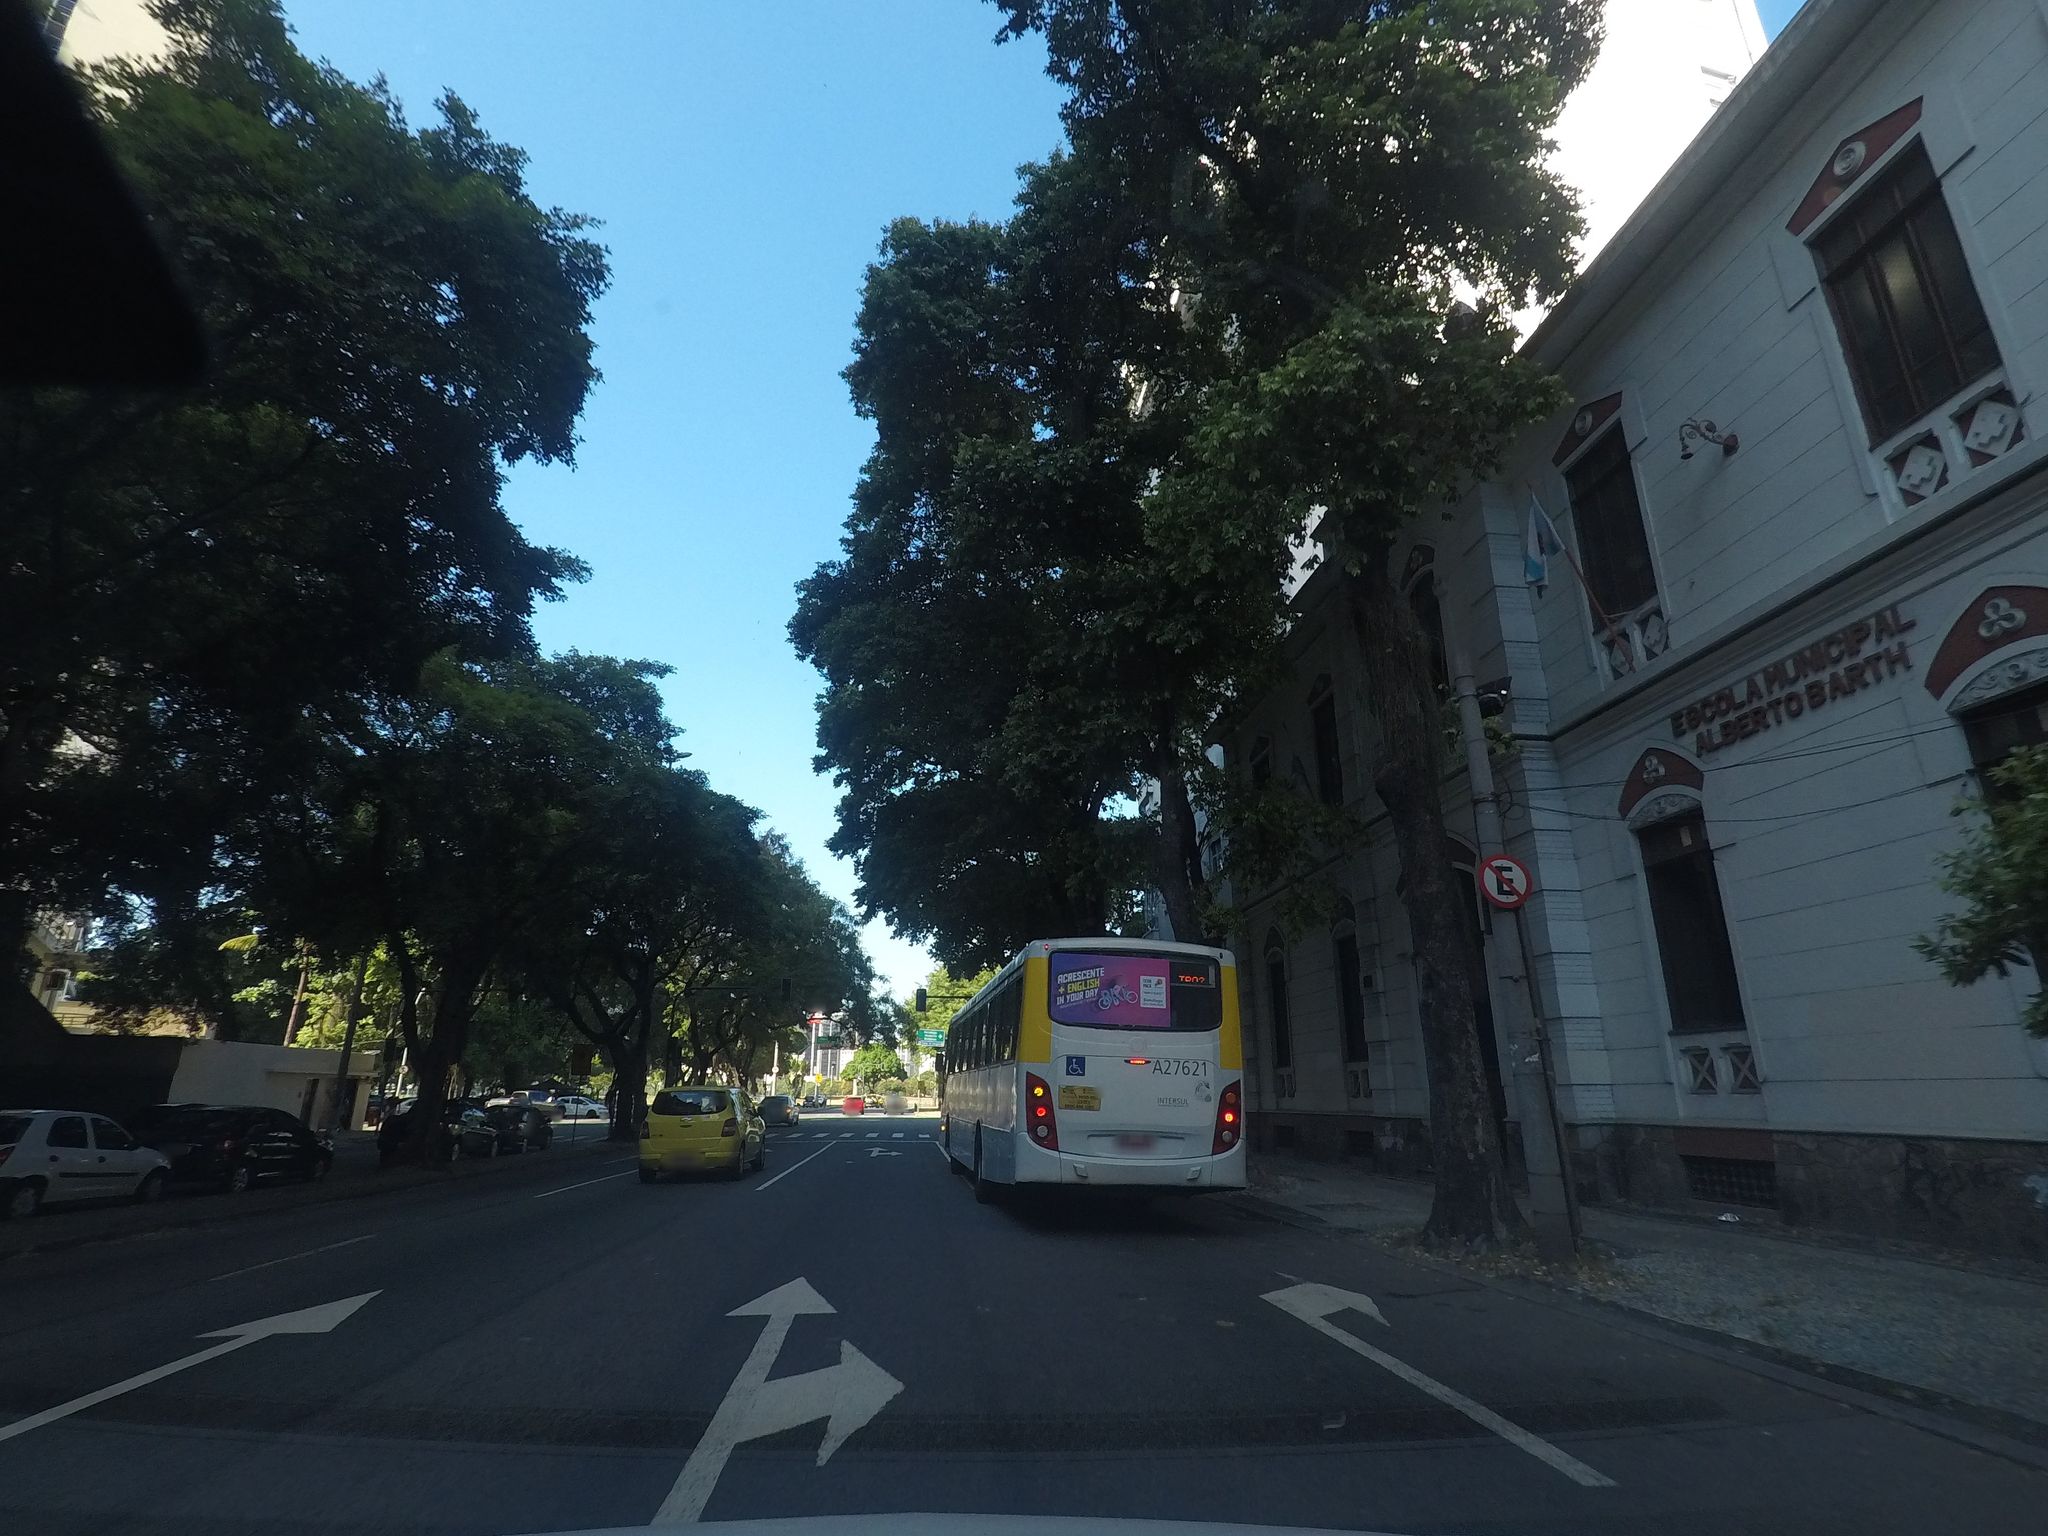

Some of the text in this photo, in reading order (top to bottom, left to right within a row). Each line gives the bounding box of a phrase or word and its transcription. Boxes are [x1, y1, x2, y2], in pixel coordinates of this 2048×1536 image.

[1670, 606, 1917, 738] ESCOLA MUNICIPAL
[1695, 640, 1913, 758] ALBERTO BARTH
[1494, 865, 1516, 896] E
[1057, 967, 1105, 984] ACRESCENTE
[1067, 977, 1100, 994] ENGLISH
[1056, 995, 1065, 1005] IN
[1066, 991, 1084, 1003] YOUR
[1085, 987, 1099, 999] DAY
[1152, 1059, 1207, 1077] A27621
[1157, 1097, 1189, 1105] INTERSUL
